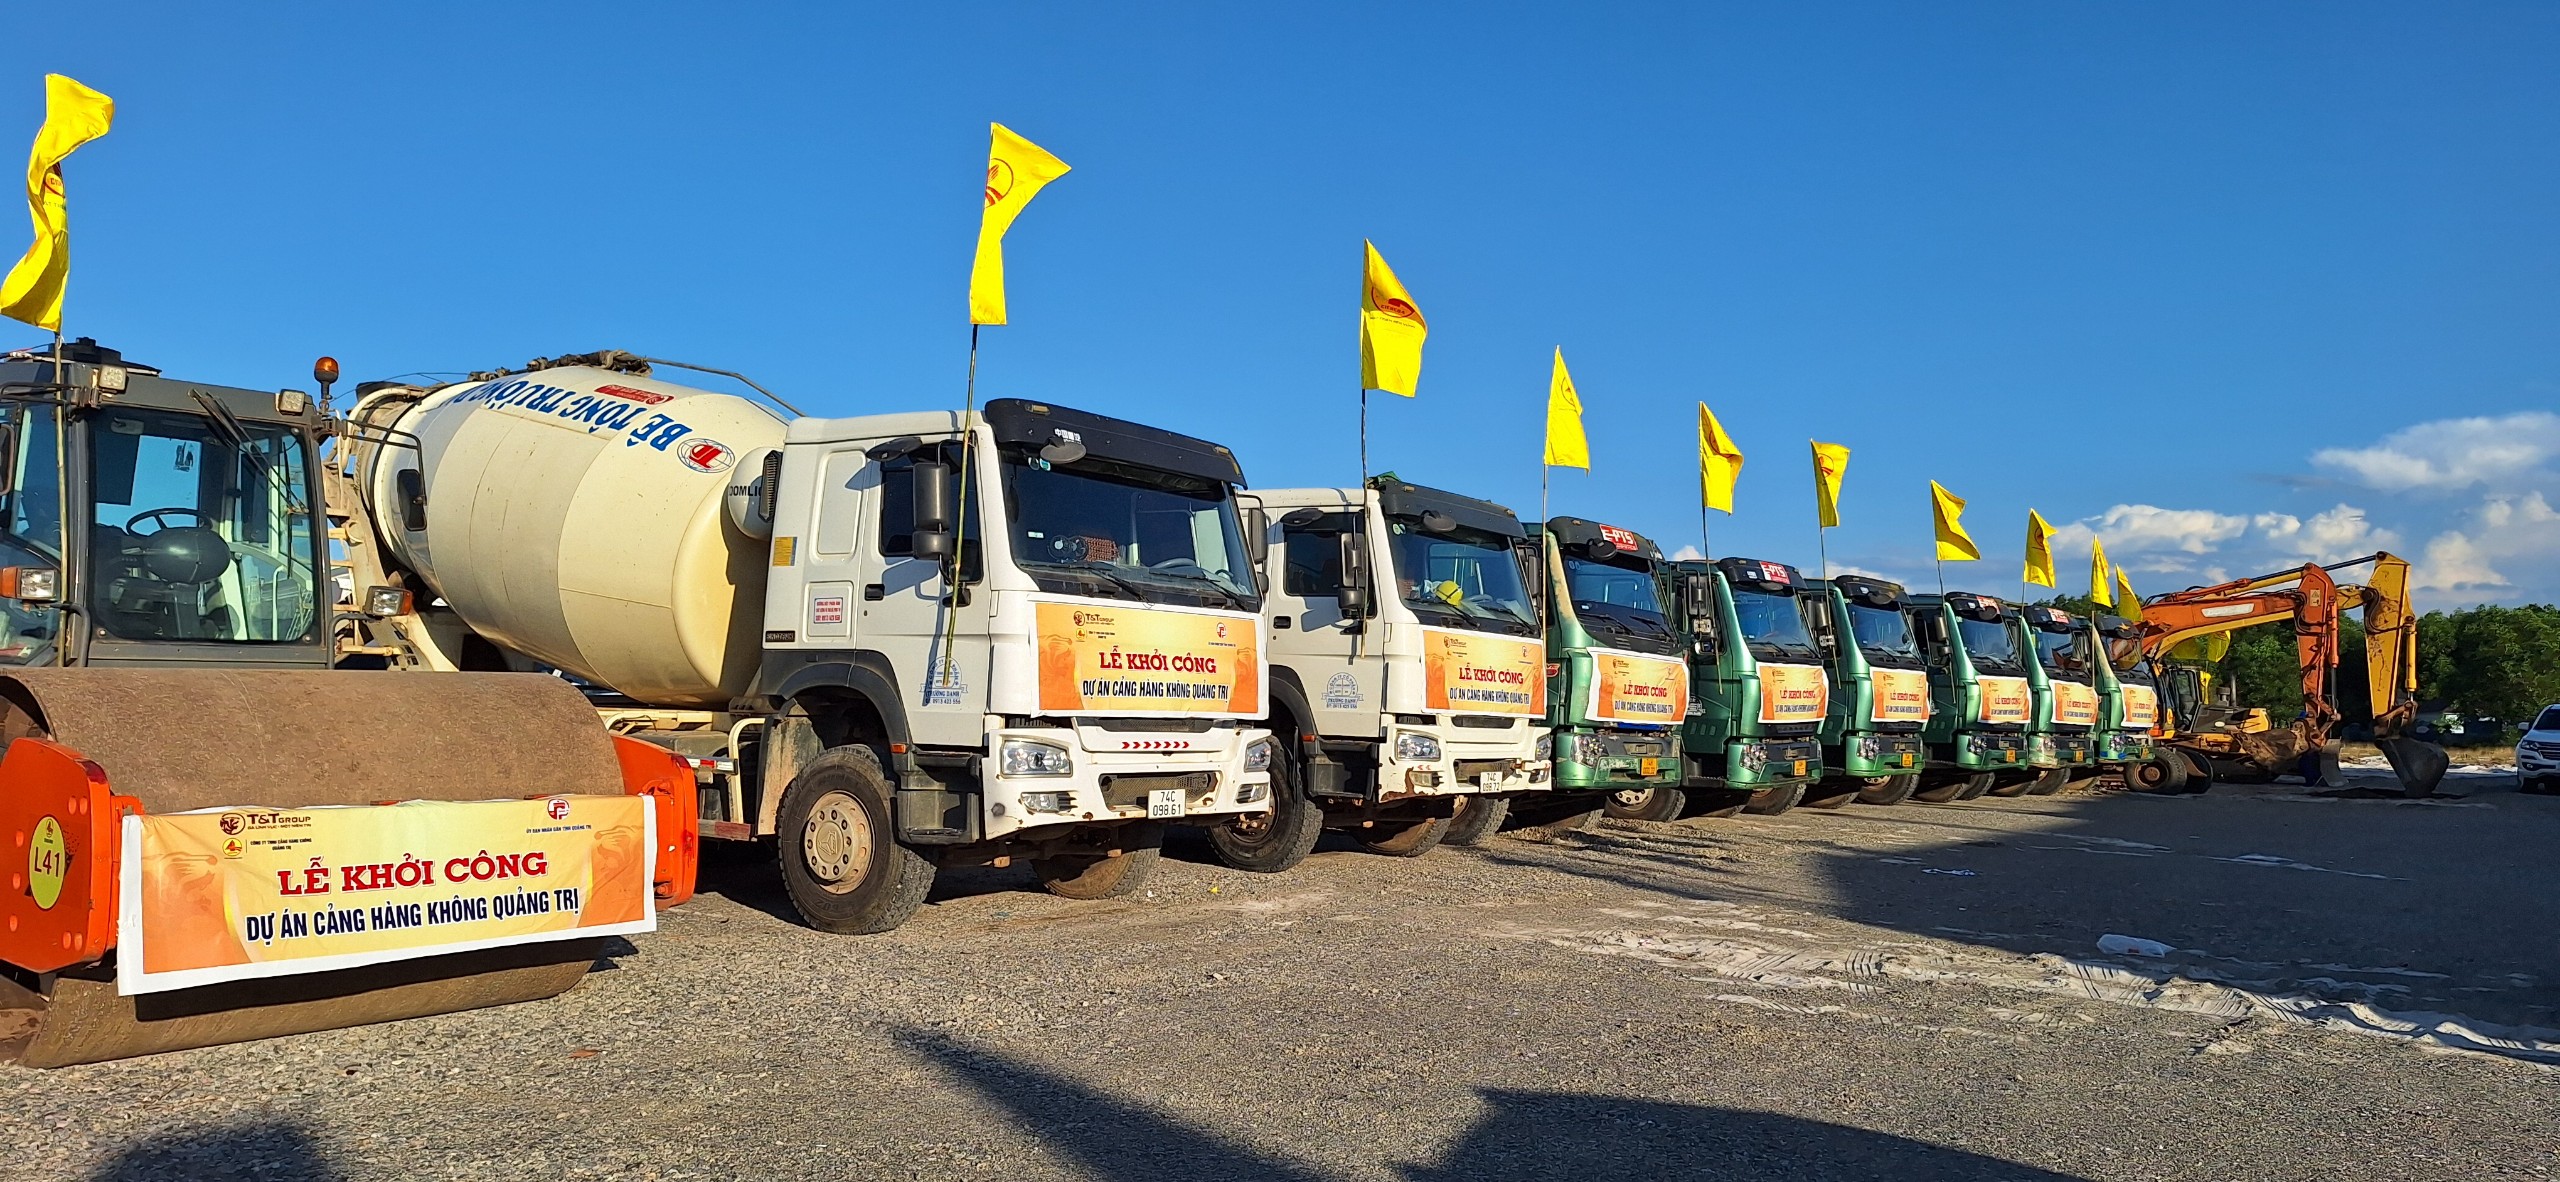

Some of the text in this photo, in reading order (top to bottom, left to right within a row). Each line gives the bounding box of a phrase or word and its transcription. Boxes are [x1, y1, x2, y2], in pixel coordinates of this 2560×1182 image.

[557, 394, 648, 434] TÔNG
[626, 412, 693, 452] BÊ
[1098, 645, 1217, 674] LỄ KHỞI CÔNG
[1458, 662, 1524, 684] LỄ KHỞI CÔNG
[1083, 675, 1228, 703] DỰ ÁN CẢNG HÀNG KHÔNG QUẢNG TRỊ
[1152, 803, 1182, 816] 098.61
[1160, 790, 1176, 802] 74C
[34, 846, 60, 877] L41
[277, 849, 548, 896] LỄ KHỞI CÔNG
[246, 886, 580, 945] DỰ ÁN CẢNG HÀNG KHÔNG QUẢNG TRỊ
